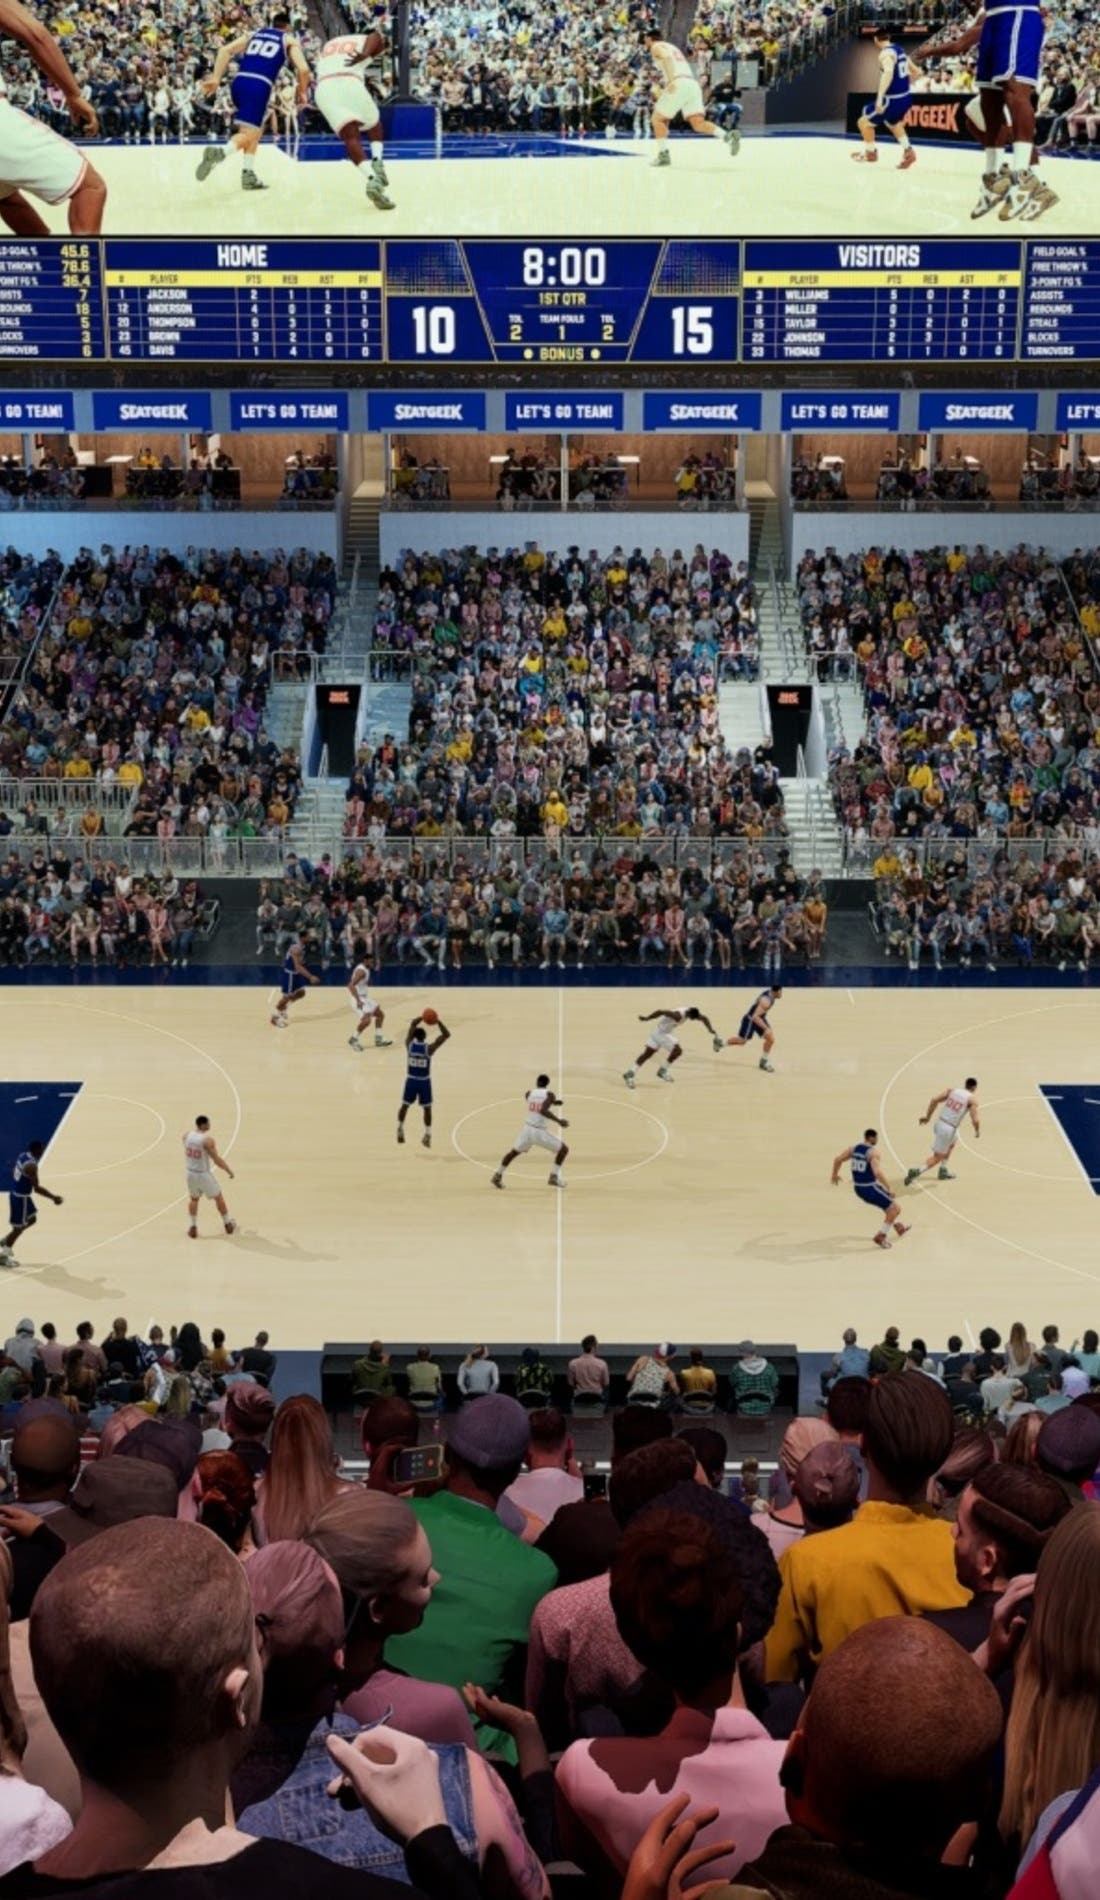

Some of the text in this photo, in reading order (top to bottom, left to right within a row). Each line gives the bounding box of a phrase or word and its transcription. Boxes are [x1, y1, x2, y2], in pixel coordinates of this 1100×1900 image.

[246, 39, 280, 58] 00
[61, 244, 89, 257] 45.6
[217, 245, 268, 267] HOME
[838, 245, 921, 267] VISITORS
[1033, 246, 1055, 256] FIELD
[1056, 246, 1077, 256] GOAL
[61, 260, 90, 272] 78.6
[523, 248, 606, 285] 8:00
[1032, 261, 1051, 272] FREE
[1052, 261, 1079, 272] THROW
[150, 274, 178, 284] PLAYER
[246, 275, 262, 284] PTS
[282, 275, 298, 284] REB
[320, 275, 334, 284] AST
[358, 275, 368, 284] PF
[789, 275, 819, 284] PLAYER
[887, 274, 902, 284] PTS
[923, 275, 938, 284] REB
[960, 275, 974, 284] AST
[998, 275, 1008, 284] PF
[1031, 276, 1061, 286] 3-POINT
[1063, 277, 1074, 286] FG
[79, 289, 88, 300] 7
[147, 289, 187, 300] JACKSON
[250, 289, 258, 300] 2
[360, 289, 368, 300] 0
[540, 292, 586, 305] 1ST QTR
[756, 289, 1006, 300] 3 WILLIAMS 5 0 2 0
[1030, 290, 1064, 300] ASSISTS
[76, 303, 90, 315] 18
[118, 303, 129, 314] 12
[147, 303, 193, 314] ANDERSON
[251, 303, 258, 314] 4
[324, 303, 332, 314] 2
[785, 304, 817, 315] MILLER
[889, 303, 897, 314] 0
[998, 303, 1005, 314] 0
[1030, 304, 1073, 314] REBOUNDS
[81, 316, 90, 329] 5
[117, 317, 130, 328] 20
[148, 317, 196, 328] THOMPSON
[251, 317, 259, 328] 0
[289, 317, 296, 328] 3
[361, 317, 369, 328] 0
[508, 314, 524, 324] TOL
[540, 314, 585, 323] TEAM FOULS
[601, 314, 616, 324] TOL
[754, 318, 764, 329] 15
[785, 318, 817, 329] TAYLOR
[889, 317, 896, 328] 3
[926, 317, 933, 328] 2
[961, 317, 968, 328] 0
[1029, 318, 1058, 328] STEALS
[412, 306, 456, 354] 10
[510, 324, 522, 340] 2
[559, 325, 565, 340] 1
[602, 324, 614, 340] 2
[672, 306, 713, 354] 15
[149, 331, 180, 342] BROWN
[252, 331, 259, 342] 3
[289, 331, 297, 342] 2
[325, 331, 333, 342] 0
[752, 332, 764, 343] 22
[784, 332, 825, 343] JOHNSON
[889, 331, 896, 342] 2
[925, 331, 932, 342] 3
[1028, 332, 1059, 342] BLOCKS
[119, 345, 132, 356] 45
[149, 345, 175, 356] DAVIS
[289, 345, 297, 356] 4
[361, 346, 369, 357] 0
[540, 348, 584, 360] BONUS
[751, 346, 764, 357] 33
[783, 346, 820, 357] THOMAS
[960, 345, 967, 356] 0
[1027, 346, 1074, 356] TURNOVERS
[6, 404, 63, 418] GO TEAM!
[120, 404, 188, 420] SEATGEEK
[240, 404, 338, 418] LET'S GO TEAM!
[394, 404, 463, 420] SEATGEEK
[516, 404, 613, 418] LET'S GO TEAM!
[670, 404, 738, 420] SEATGEEK
[791, 404, 888, 419] LET'S GO TEAM!
[945, 404, 1014, 421] SEATGEEK
